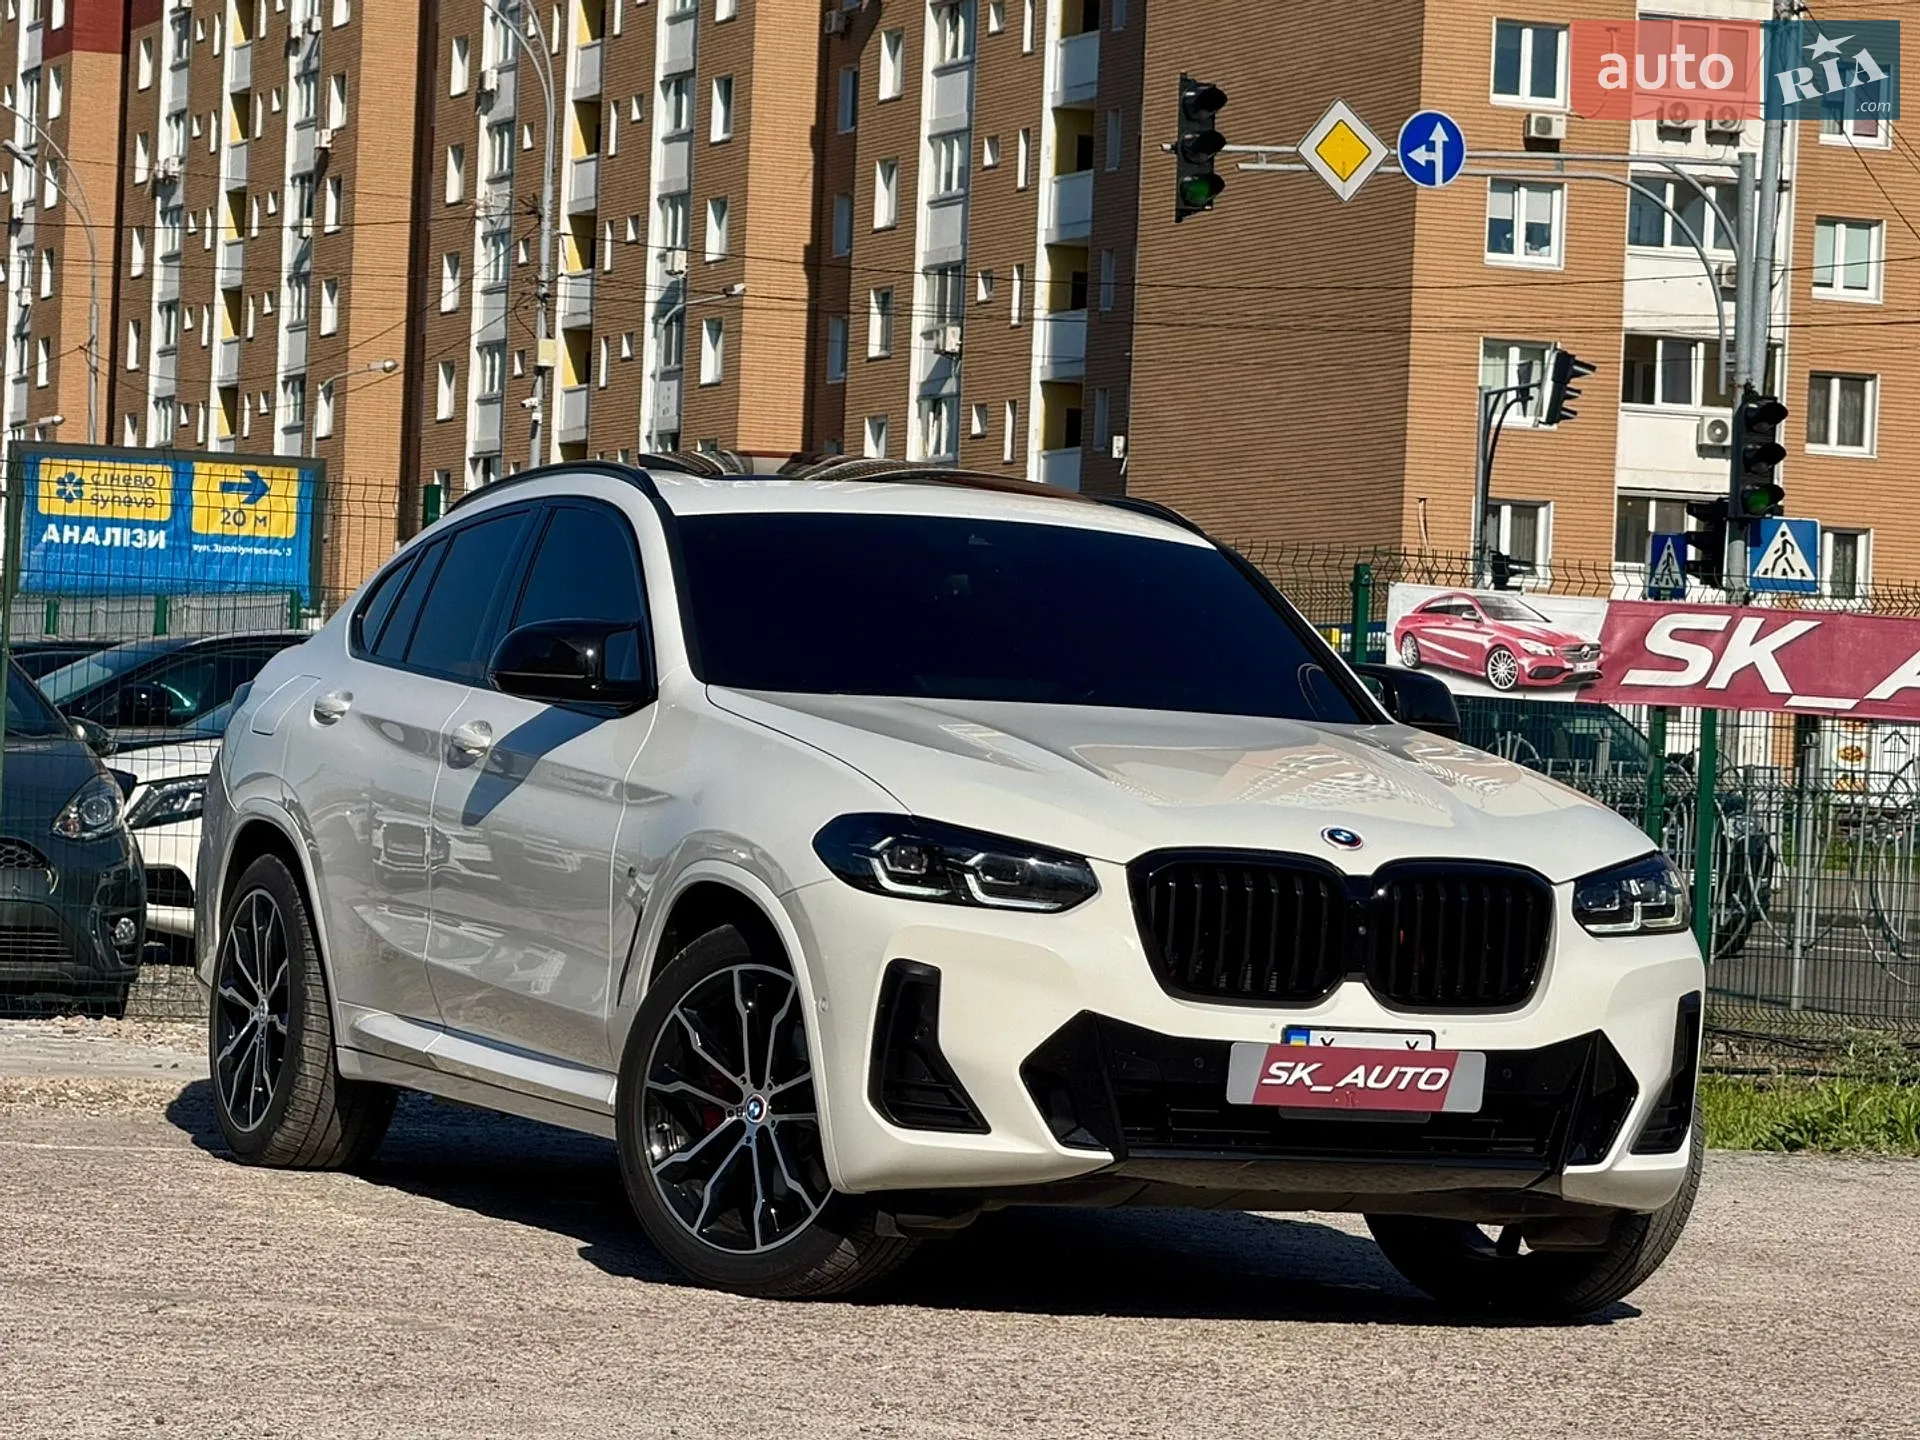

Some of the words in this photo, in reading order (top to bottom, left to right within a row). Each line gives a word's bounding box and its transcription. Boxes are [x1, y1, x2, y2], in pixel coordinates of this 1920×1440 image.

[90, 493, 156, 510] synevo
[220, 509, 247, 528] 20
[41, 523, 167, 550] АНАЛІЗИ
[1261, 1061, 1450, 1092] SK_AUTO
